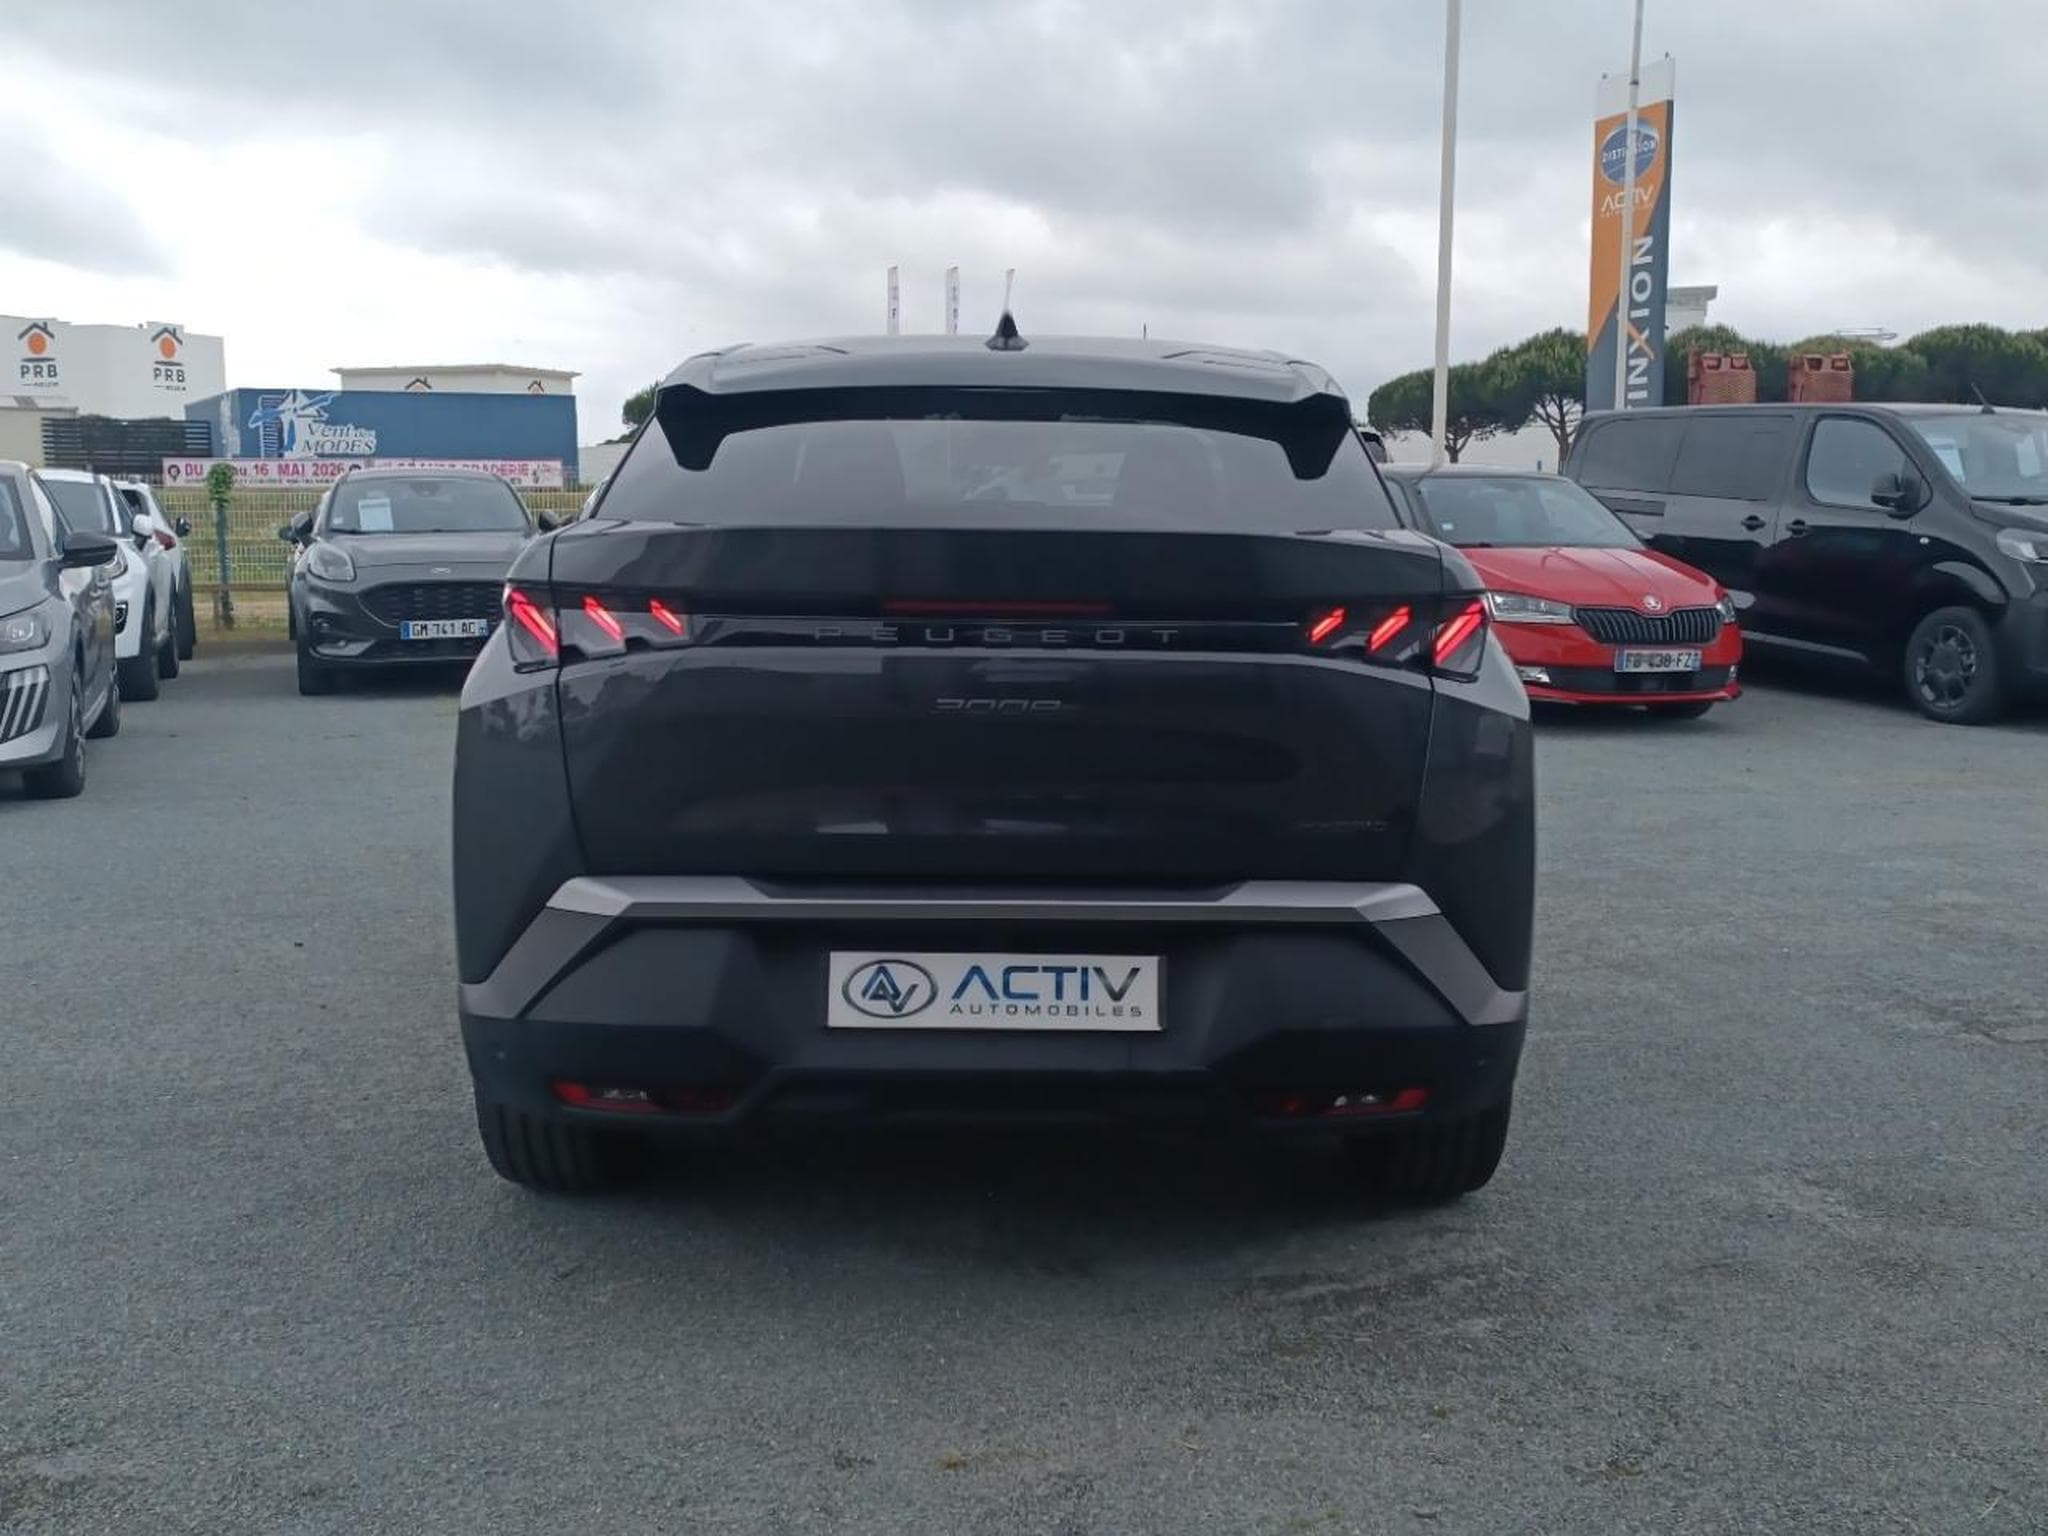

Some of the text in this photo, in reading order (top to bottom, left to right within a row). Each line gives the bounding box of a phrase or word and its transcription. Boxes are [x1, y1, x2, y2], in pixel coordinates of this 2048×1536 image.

[1601, 186, 1655, 210] ACIV
[20, 364, 58, 379] PRB
[153, 367, 186, 383] PRB
[302, 439, 376, 453] MODES
[185, 463, 204, 477] DU
[254, 463, 270, 476] 16
[277, 463, 306, 477] MAI
[312, 463, 346, 477] 2026
[814, 627, 1178, 644] PEUGEOT
[952, 964, 1140, 1002] ACTIV
[950, 1003, 1142, 1017] AUTOMOBILES
